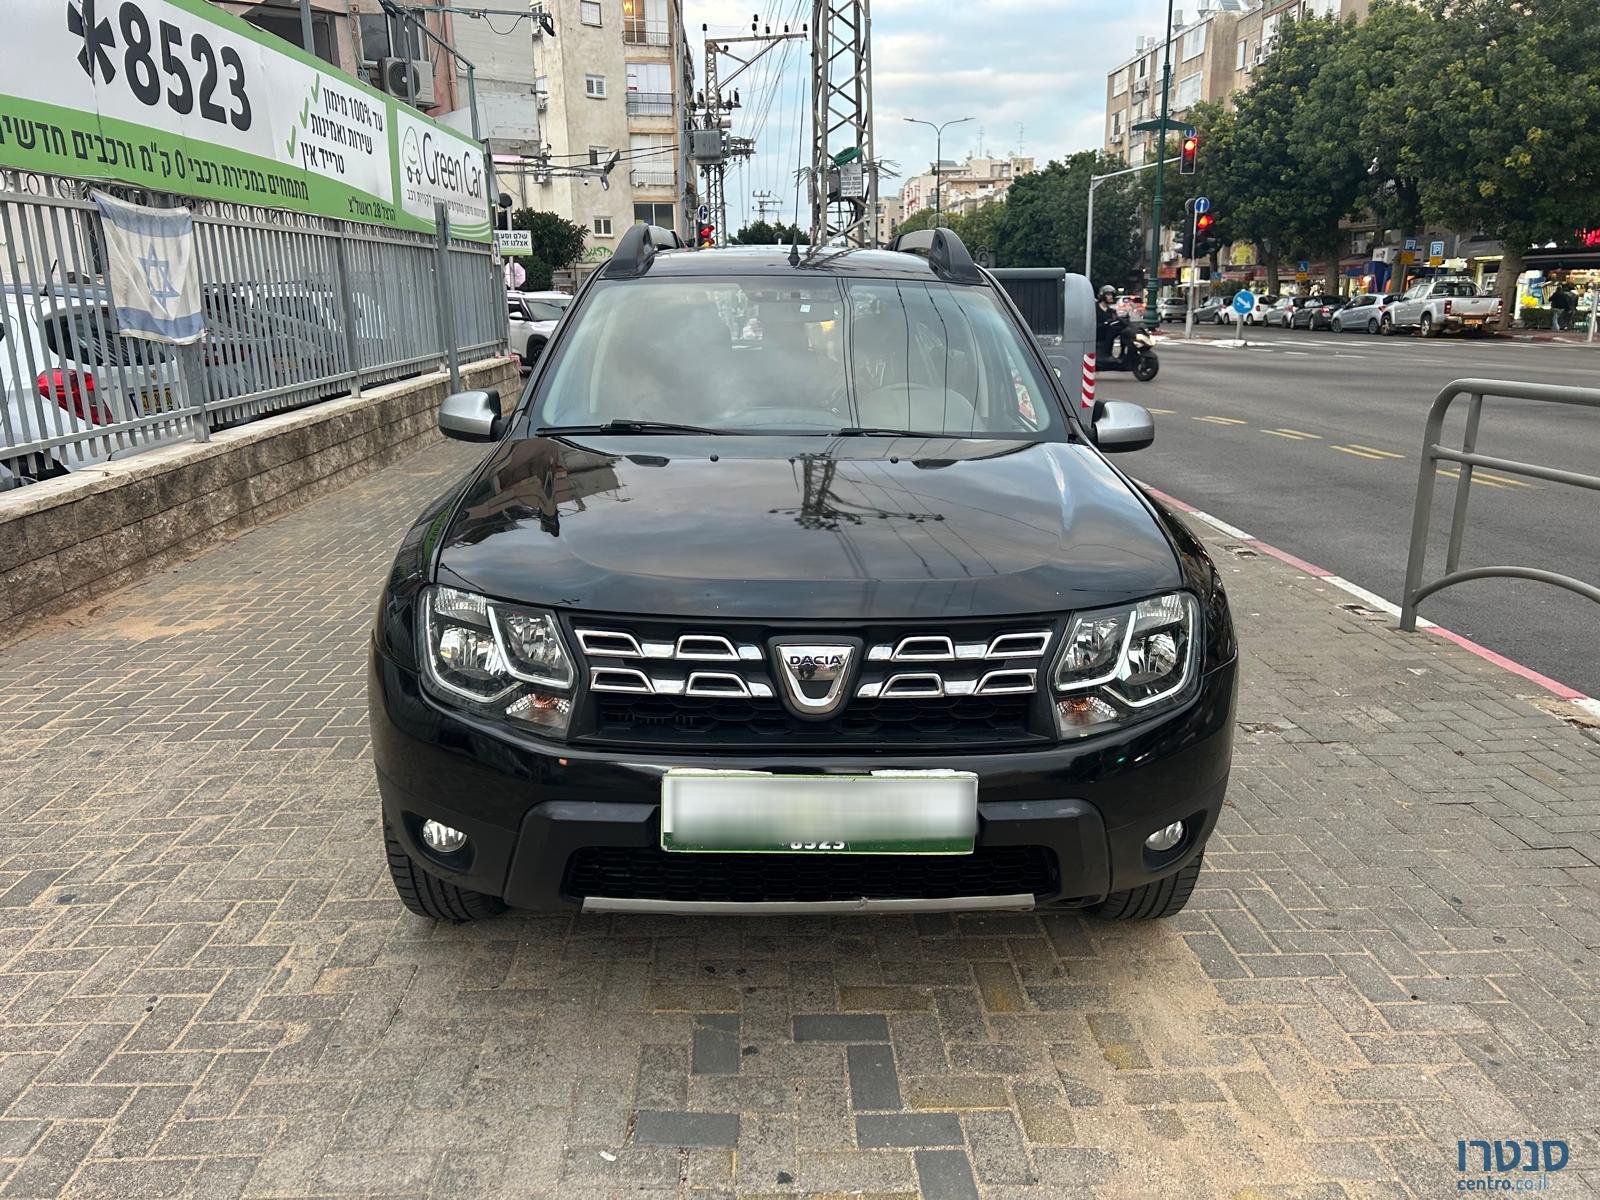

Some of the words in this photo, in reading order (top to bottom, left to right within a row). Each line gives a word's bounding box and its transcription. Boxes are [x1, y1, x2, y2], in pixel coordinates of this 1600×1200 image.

[323, 87, 348, 117] מימון
[349, 97, 372, 127] 100%
[310, 113, 347, 145] ואמינות
[372, 111, 383, 132] עד
[0, 115, 68, 157] חדשי
[71, 130, 136, 169] ורכבים
[347, 128, 373, 155] שירות
[300, 141, 318, 171] אין
[318, 147, 345, 174] טרייד
[422, 132, 464, 194] Green
[463, 151, 482, 199] Car
[188, 157, 220, 185] רכבי
[221, 164, 267, 193] במכירת
[267, 174, 309, 201] מתמחים
[372, 202, 382, 219] 28
[382, 206, 396, 221] הרצל
[514, 232, 528, 240] שלם
[790, 655, 841, 665] DACIA
